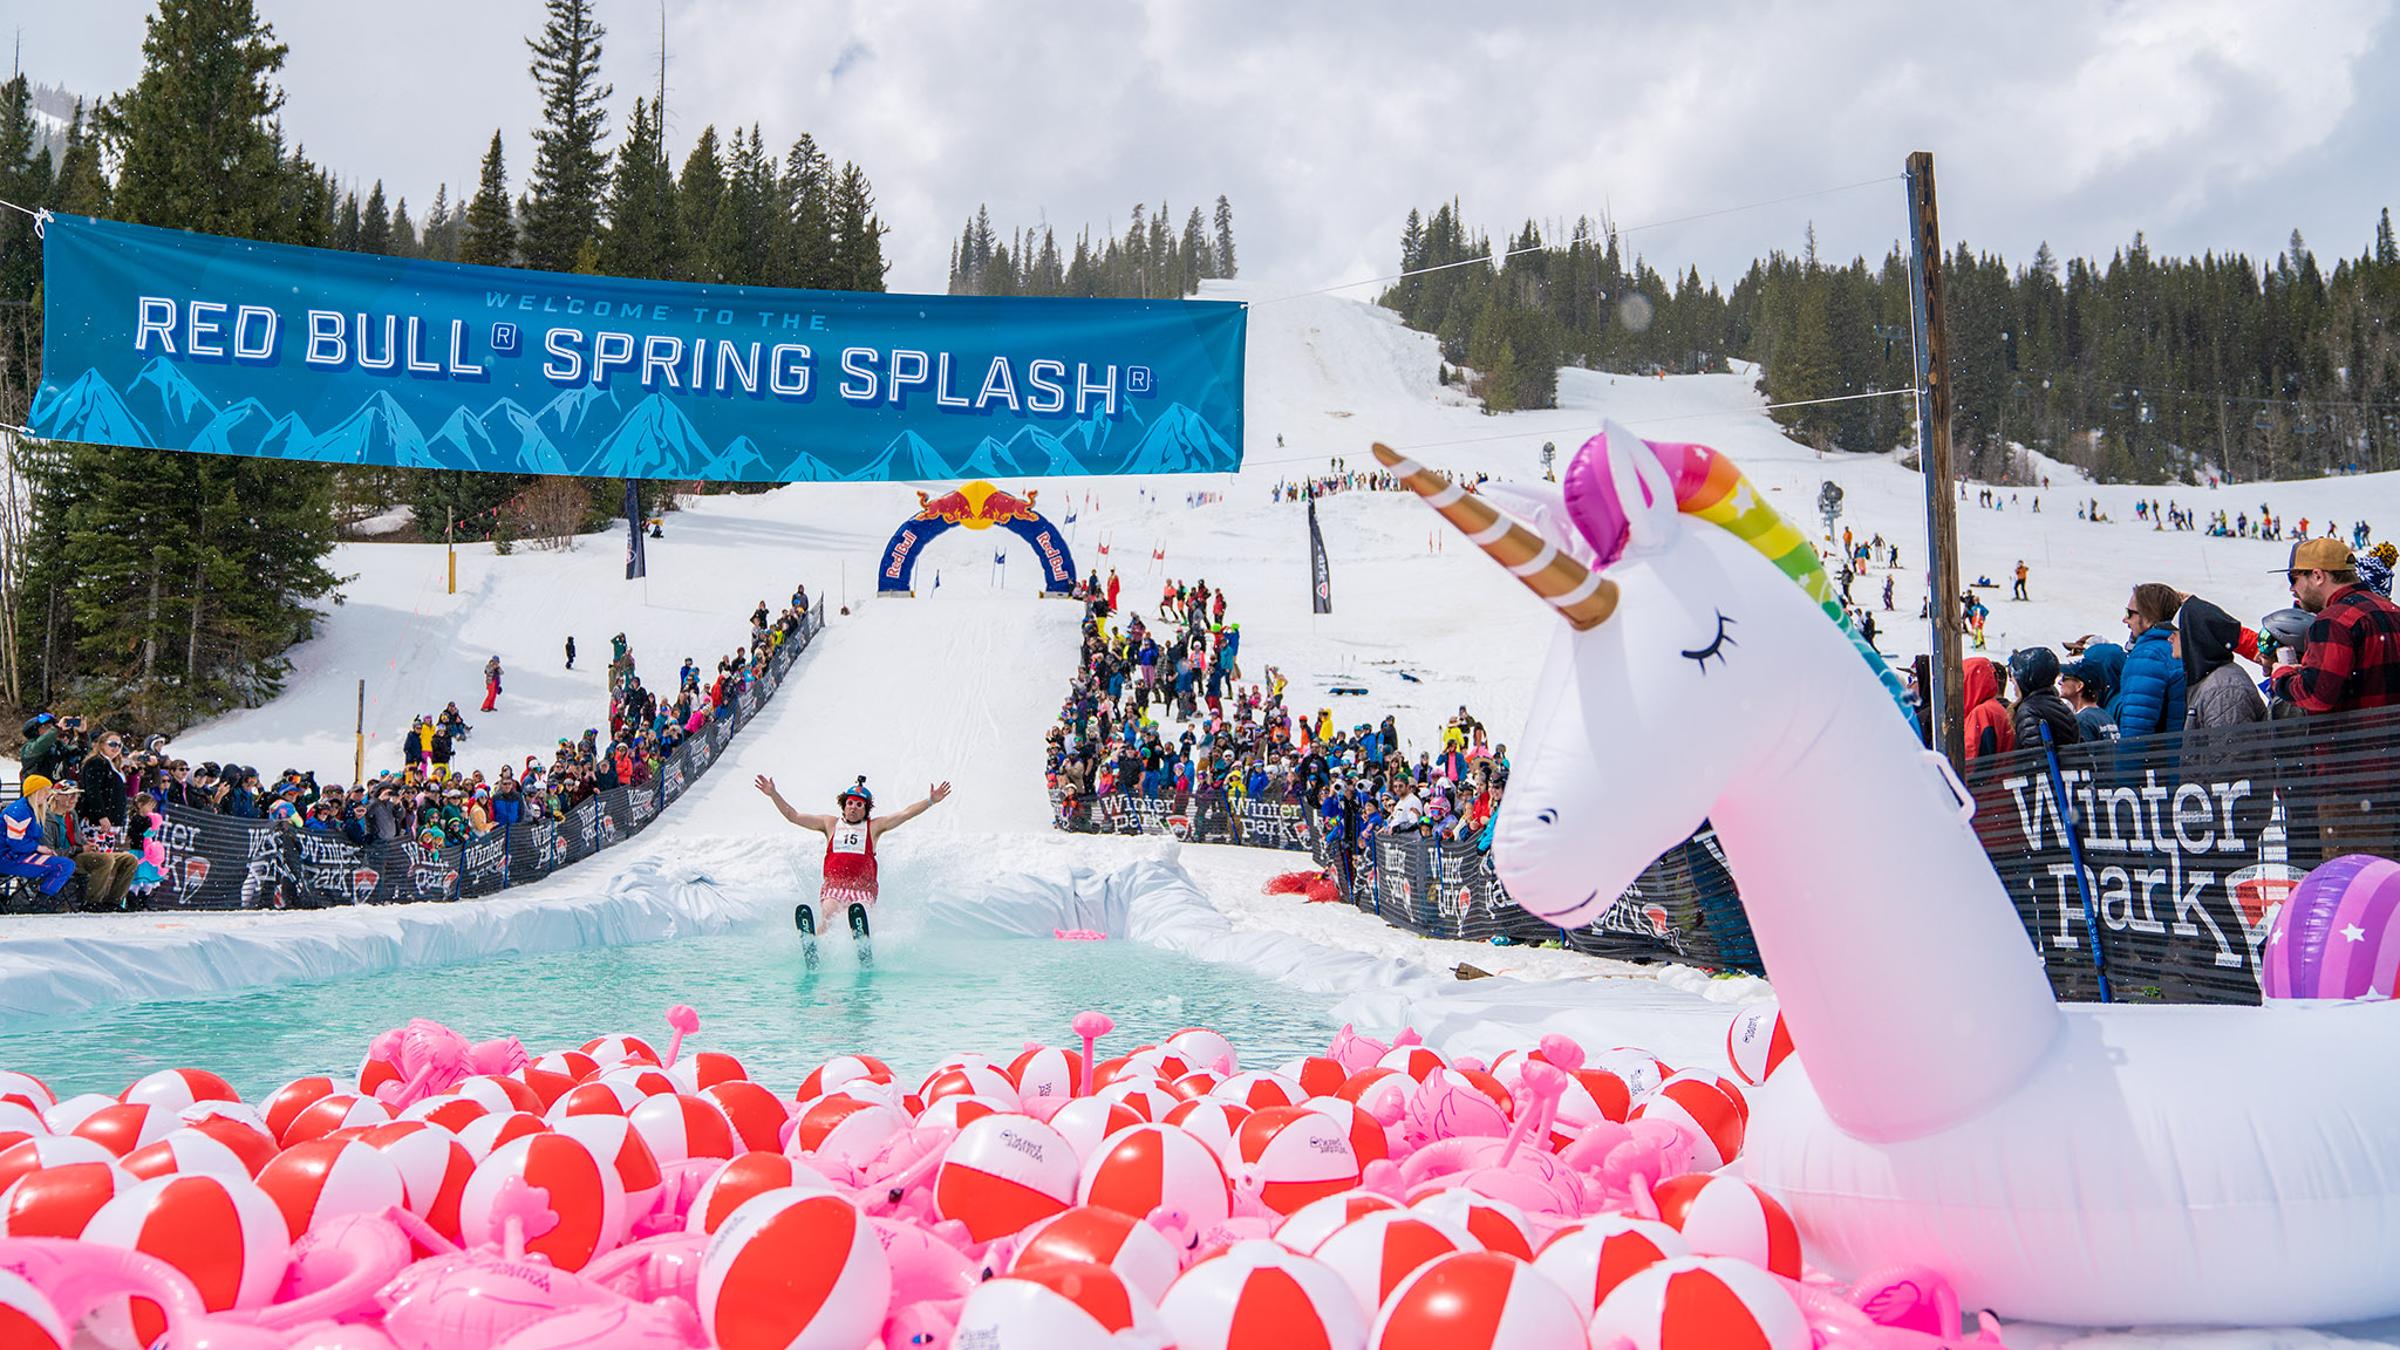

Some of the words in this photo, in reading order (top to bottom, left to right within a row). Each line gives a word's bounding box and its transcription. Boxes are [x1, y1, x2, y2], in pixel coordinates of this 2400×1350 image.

[485, 291, 669, 320] WELCOME
[693, 308, 734, 326] TO
[758, 312, 827, 331] THE
[135, 296, 281, 362] RED
[542, 326, 812, 397] SPRING
[886, 552, 905, 579] Red
[896, 529, 917, 556] Bull
[1036, 531, 1060, 558] Red
[1049, 553, 1069, 582] Bull
[1102, 794, 1176, 815] Winter
[1228, 797, 1302, 820] Winter
[2003, 769, 2251, 854] Winter
[296, 833, 361, 864] Winter
[844, 834, 857, 845] 15
